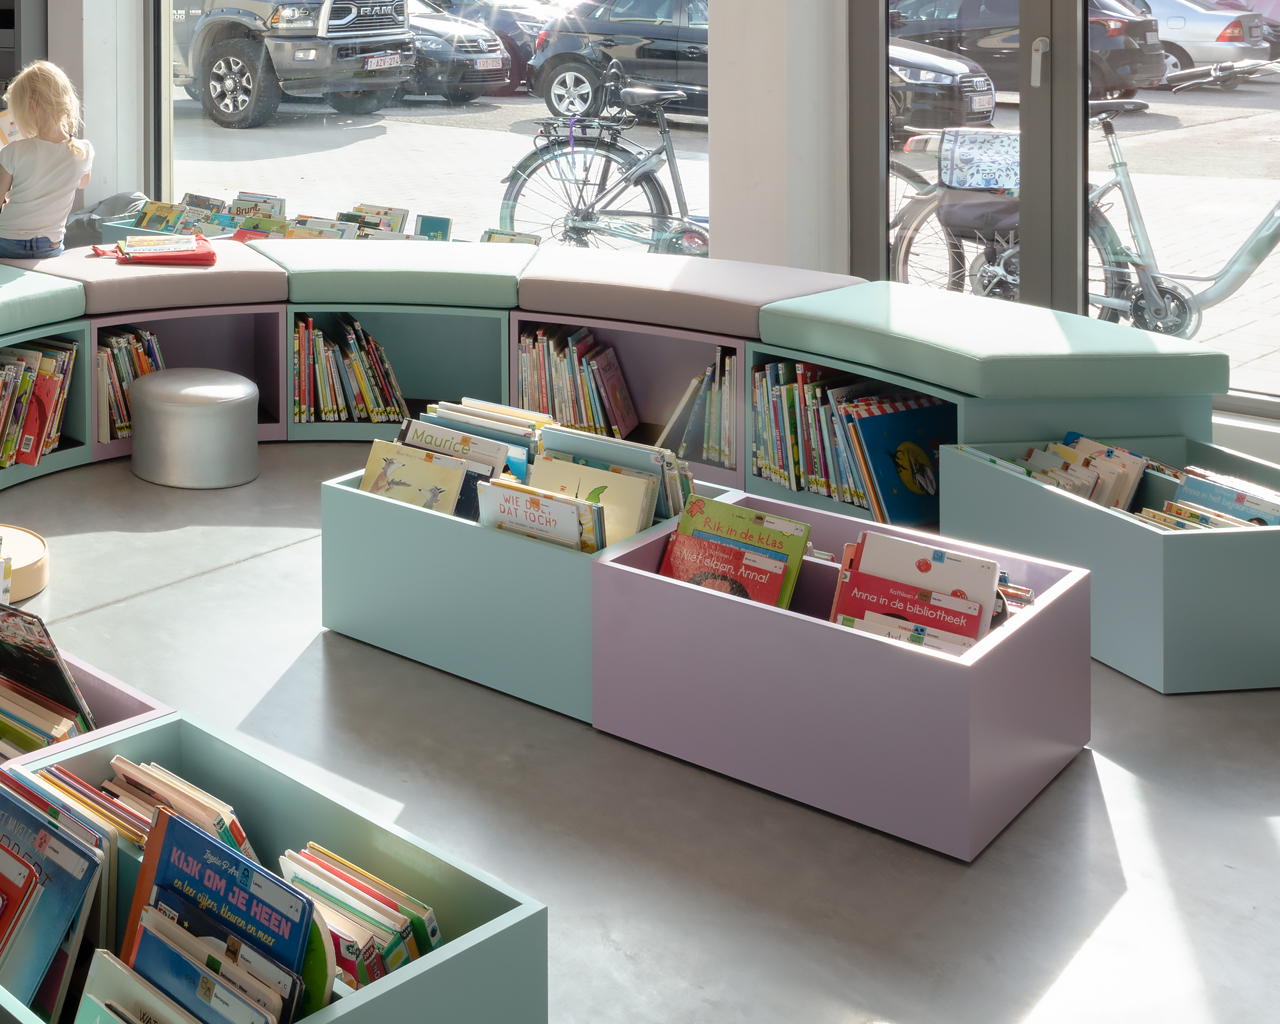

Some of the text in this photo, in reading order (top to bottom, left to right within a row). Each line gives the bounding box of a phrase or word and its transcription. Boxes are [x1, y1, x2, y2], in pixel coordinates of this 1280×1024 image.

[360, 6, 392, 15] RAM
[411, 427, 471, 455] Maurice
[502, 493, 520, 507] WIE
[499, 503, 519, 519] DAT
[523, 510, 558, 528] TOCH?
[703, 516, 724, 534] Rik
[726, 526, 738, 539] in
[739, 528, 754, 542] de
[757, 532, 784, 550] klas
[680, 547, 703, 564] Niet
[737, 565, 771, 584] Anna!
[889, 588, 914, 599] Kathleen
[850, 586, 967, 627] Anna in de bibliotheek
[202, 849, 222, 866] Ingela
[170, 846, 292, 940] KIJK OM JE HEEN
[173, 878, 183, 891] en
[182, 880, 196, 898] leer
[196, 890, 219, 915] cijfers,
[219, 903, 246, 930] kleuren
[246, 924, 257, 936] en
[256, 929, 276, 947] meer
[240, 953, 252, 965] Slapen
[213, 992, 230, 1008] Beroepen
